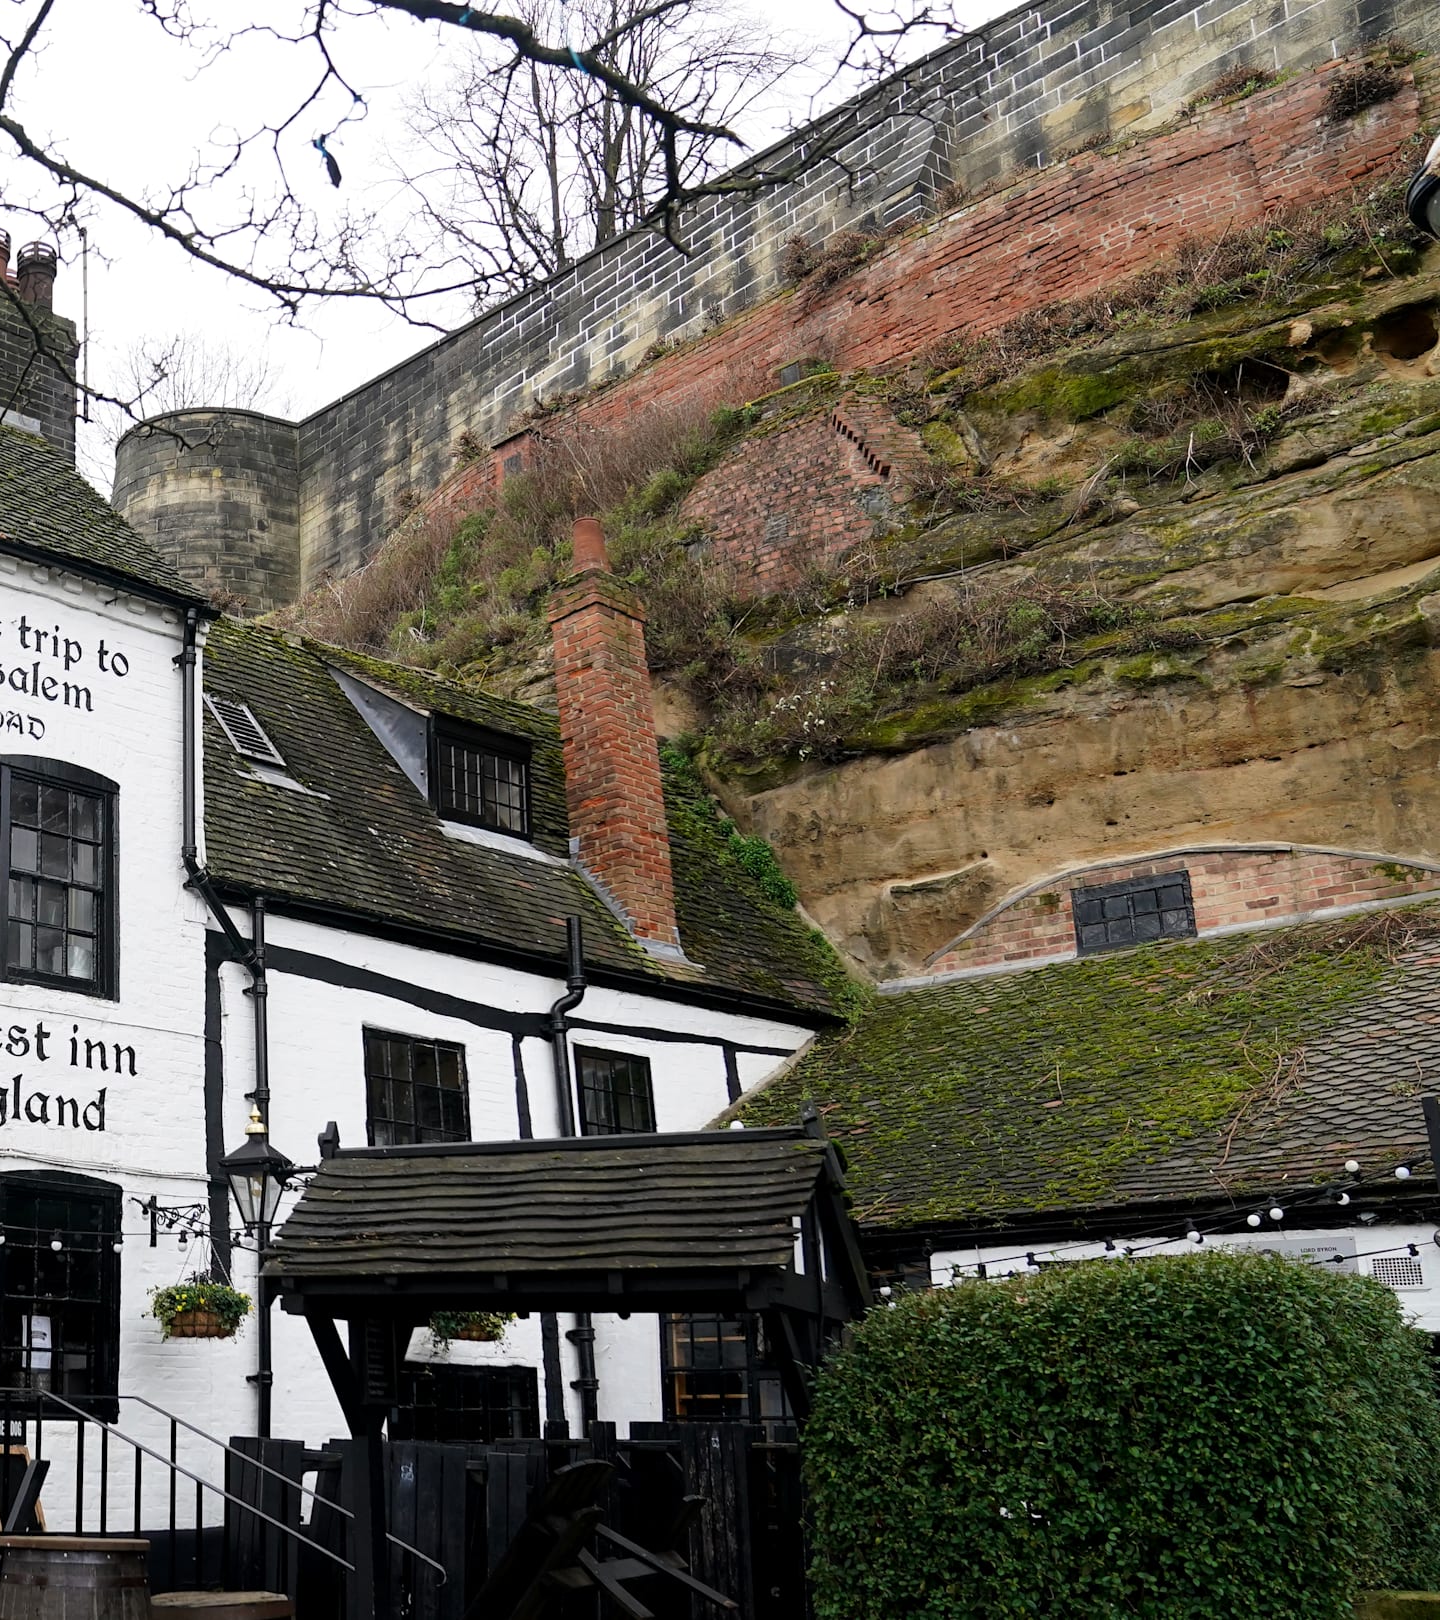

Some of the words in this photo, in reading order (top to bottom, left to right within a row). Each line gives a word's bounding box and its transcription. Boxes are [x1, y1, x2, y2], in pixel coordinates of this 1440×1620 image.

[18, 615, 82, 670] trip
[98, 639, 129, 677] to
[70, 1024, 137, 1076] inn
